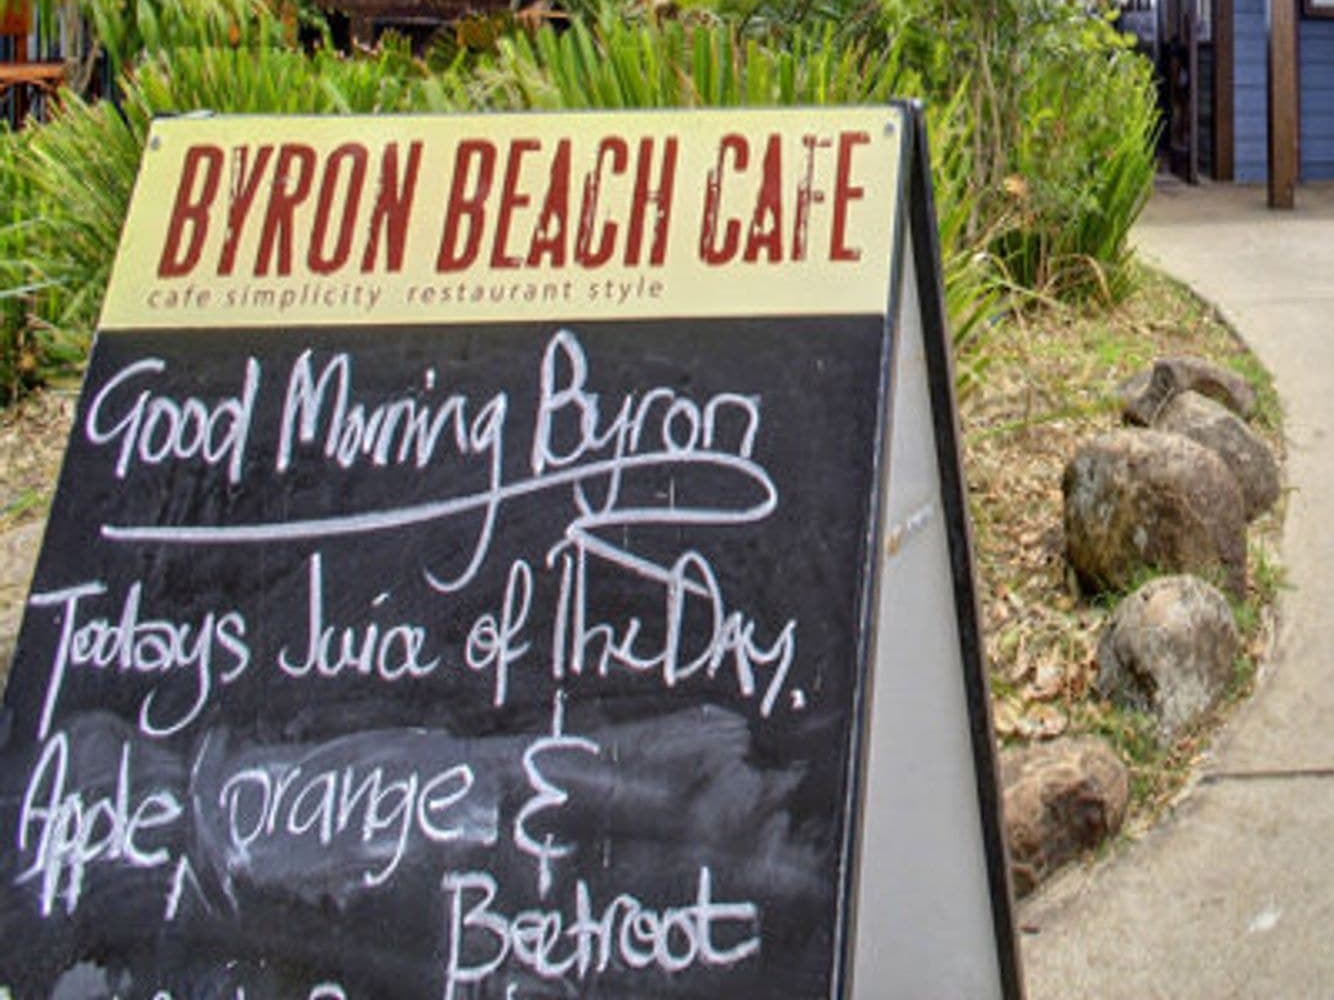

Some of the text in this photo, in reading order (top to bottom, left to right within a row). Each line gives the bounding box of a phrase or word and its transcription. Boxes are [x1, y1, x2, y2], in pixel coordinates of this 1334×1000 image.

[157, 131, 872, 279] BYRON BEACH CAFE
[148, 275, 664, 311] cafe simplicity restaurant style
[86, 328, 762, 592] Good Morning Byron
[28, 580, 250, 740] Todays
[465, 559, 531, 707] of
[442, 865, 762, 1000] Beetroot
